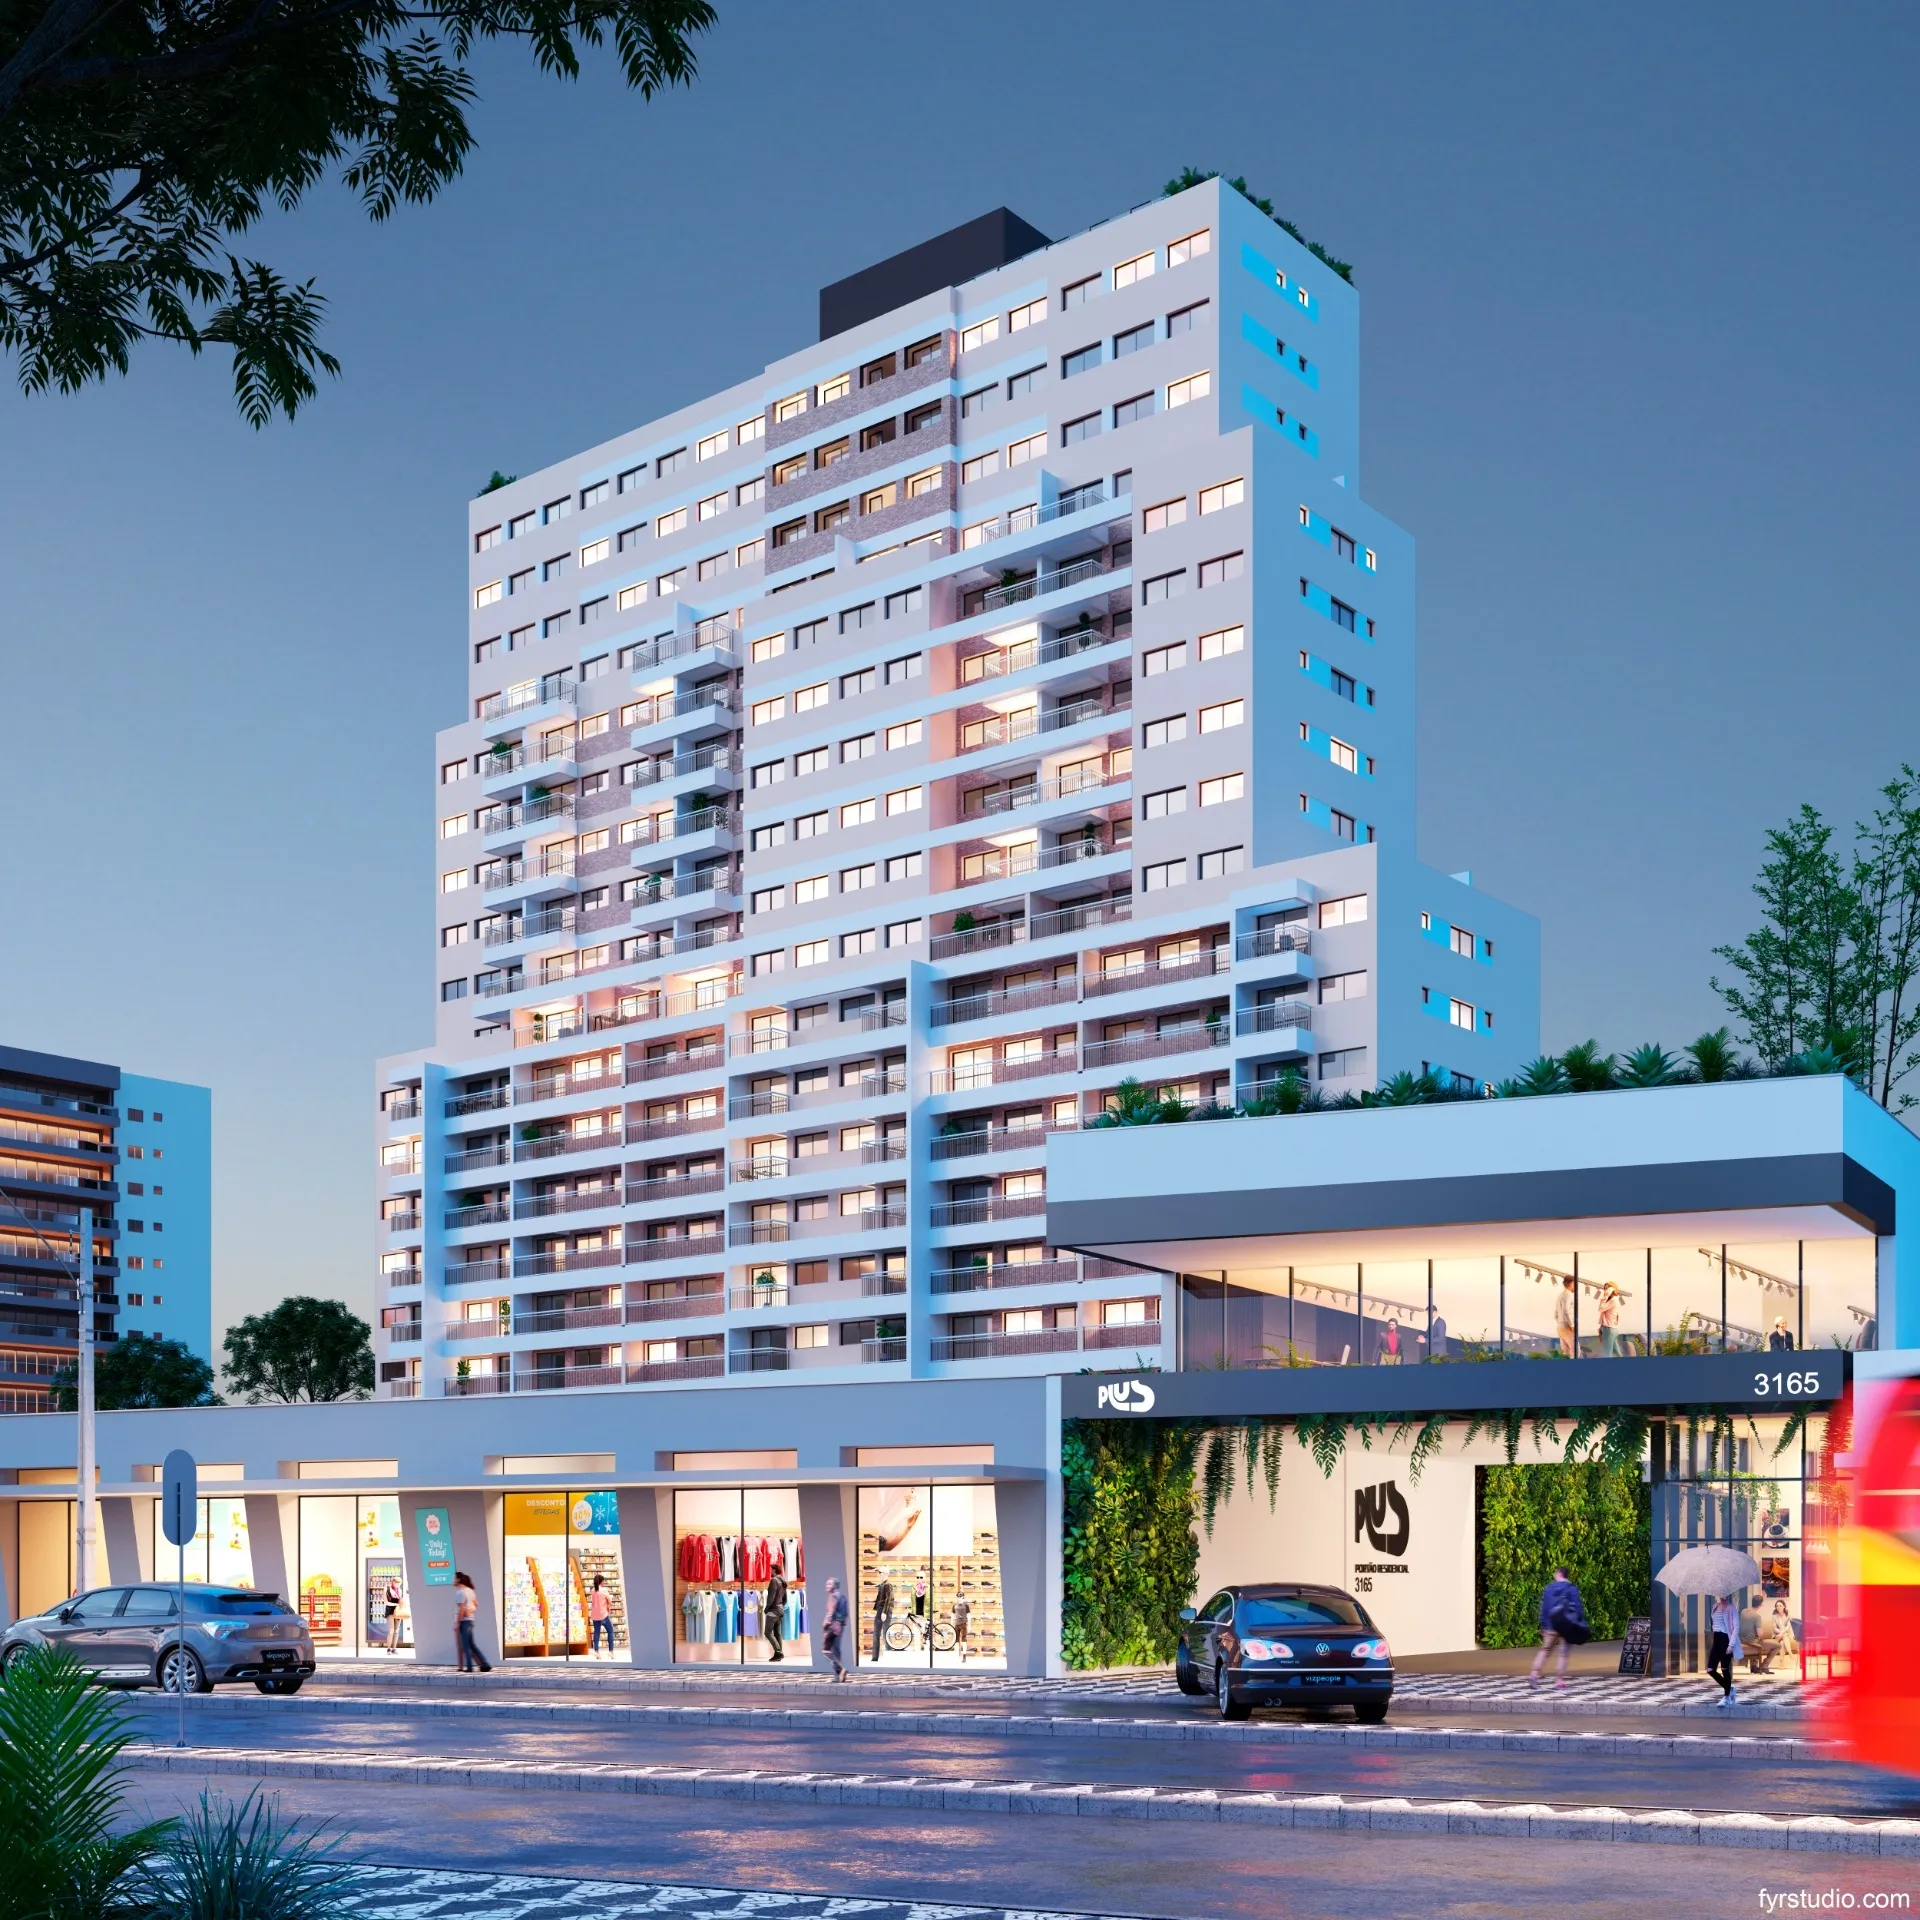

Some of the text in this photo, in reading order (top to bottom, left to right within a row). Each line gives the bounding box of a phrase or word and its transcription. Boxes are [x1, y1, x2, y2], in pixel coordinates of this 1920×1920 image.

[1754, 1372, 1820, 1396] 3165
[526, 1499, 566, 1507] DESCONTO
[1354, 1561, 1377, 1574] PORTÃO
[1354, 1577, 1373, 1592] 3165
[1305, 1675, 1341, 1684] vizpeople
